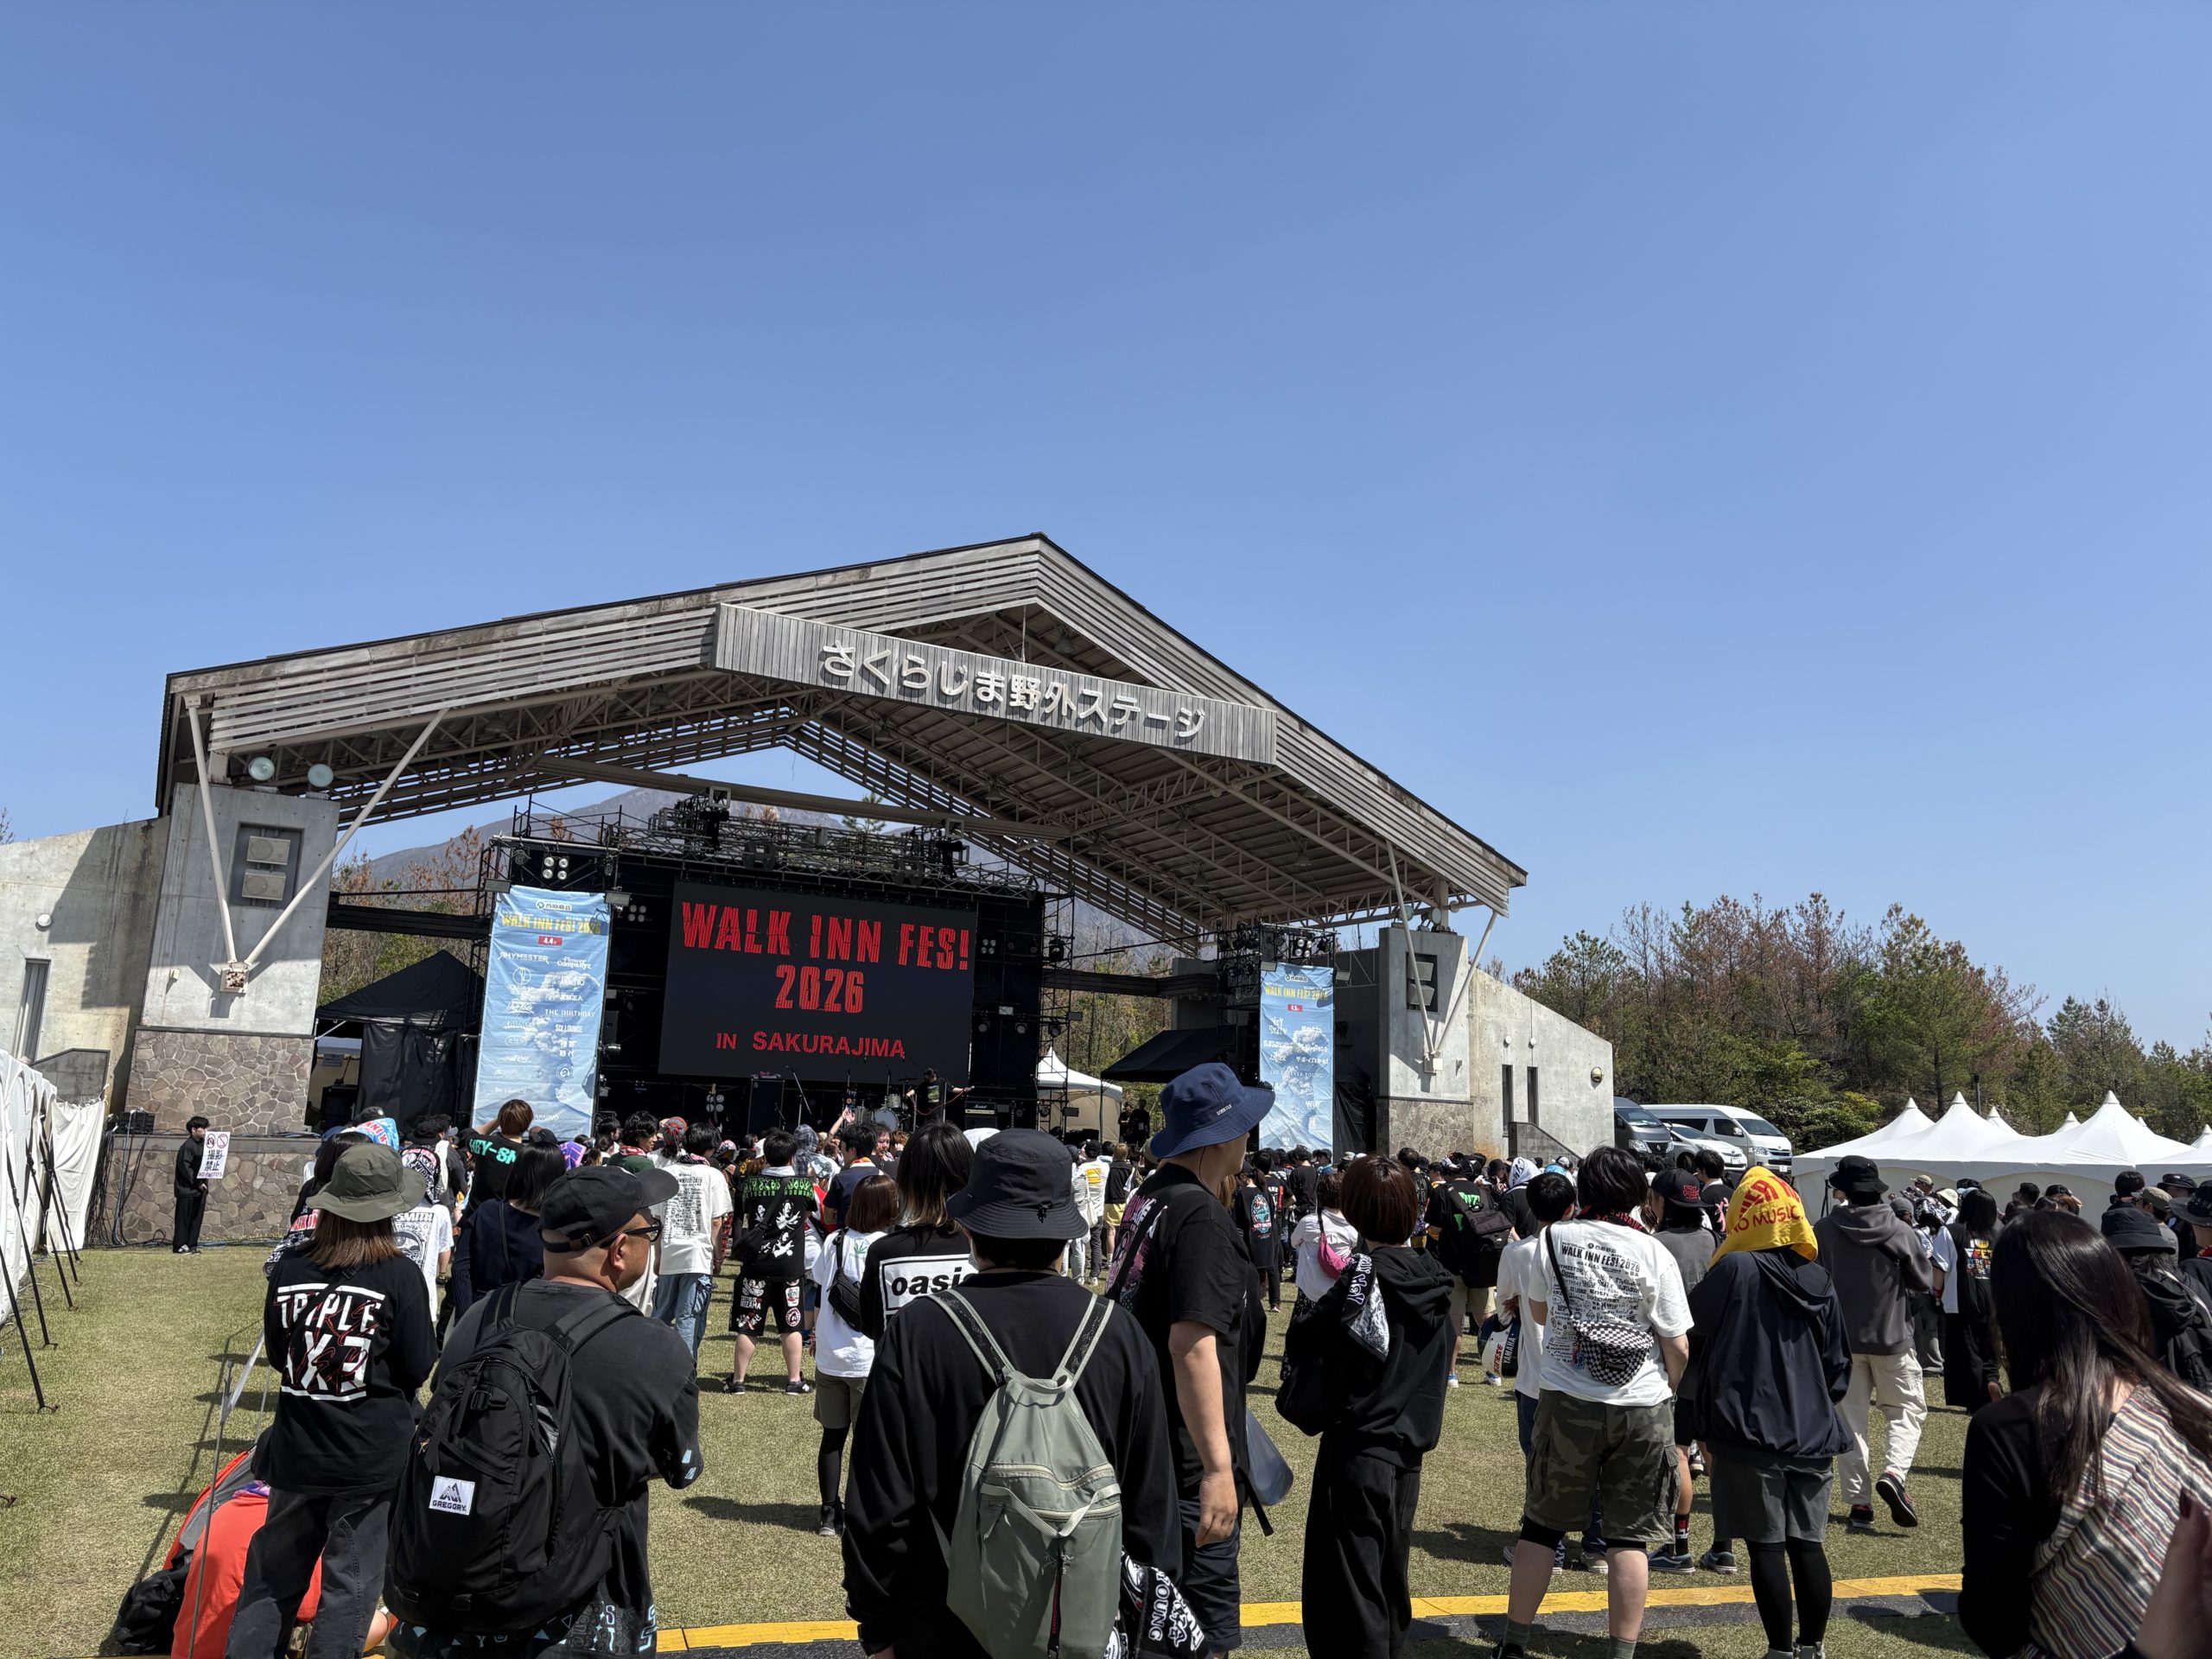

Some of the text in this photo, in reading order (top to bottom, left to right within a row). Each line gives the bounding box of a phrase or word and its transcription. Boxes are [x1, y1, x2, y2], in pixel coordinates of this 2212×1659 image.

[822, 639, 1206, 738] さくらじま野外ステージ
[682, 901, 969, 970] WALK INN FES!
[498, 951, 550, 964] RHYMESTER
[775, 964, 865, 1014] 2026
[715, 1031, 906, 1058] IN SAKURAJIMA
[204, 1160, 220, 1172] 禁止
[1561, 1244, 1640, 1273] WALK INN FES! 2026
[892, 1267, 969, 1296] oasi
[1503, 1337, 1516, 1363] YAMAHA
[432, 1500, 467, 1512] GREGORY
